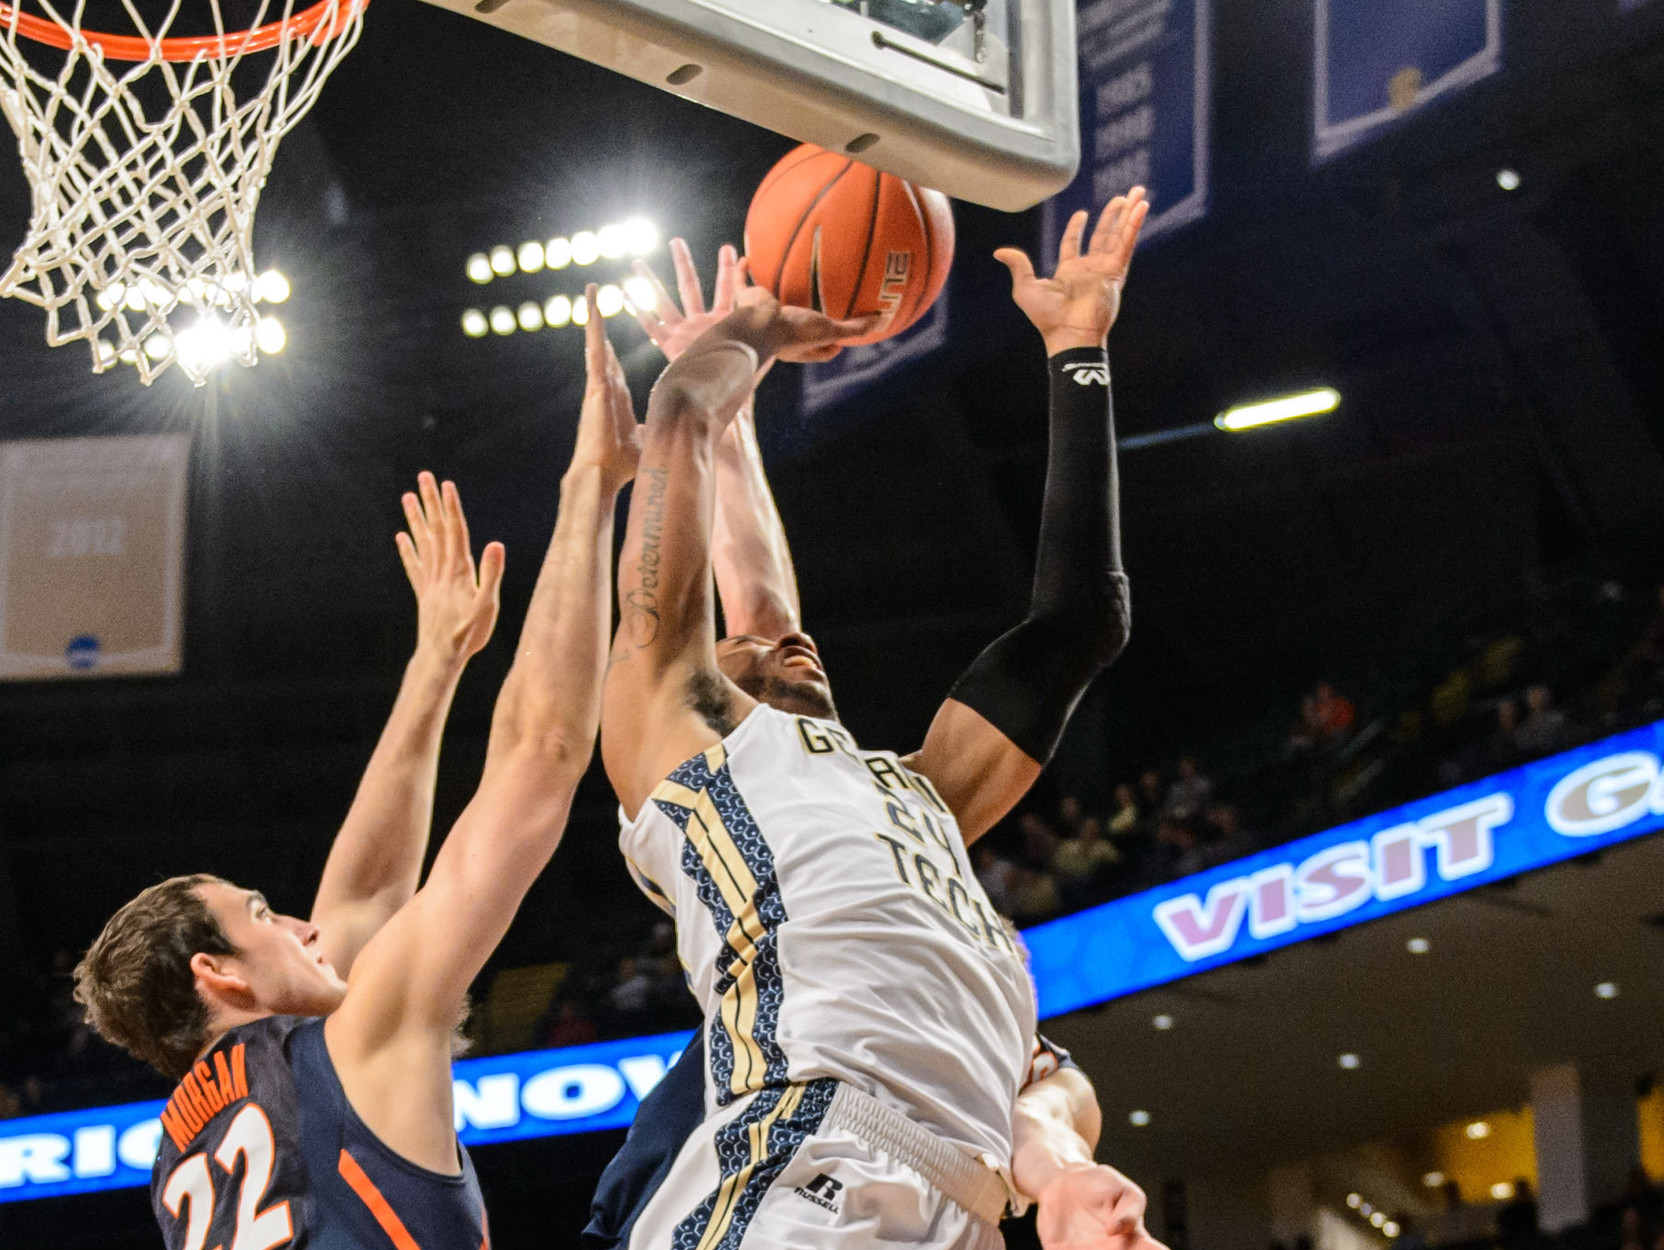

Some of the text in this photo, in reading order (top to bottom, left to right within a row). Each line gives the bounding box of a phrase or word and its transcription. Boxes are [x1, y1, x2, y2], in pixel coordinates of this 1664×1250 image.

[626, 467, 670, 649] Determined
[873, 831, 1016, 960] TECH
[1153, 750, 1664, 962] VISIT G
[160, 1043, 249, 1153] MORGAN
[794, 1186, 839, 1215] RUSSELL
